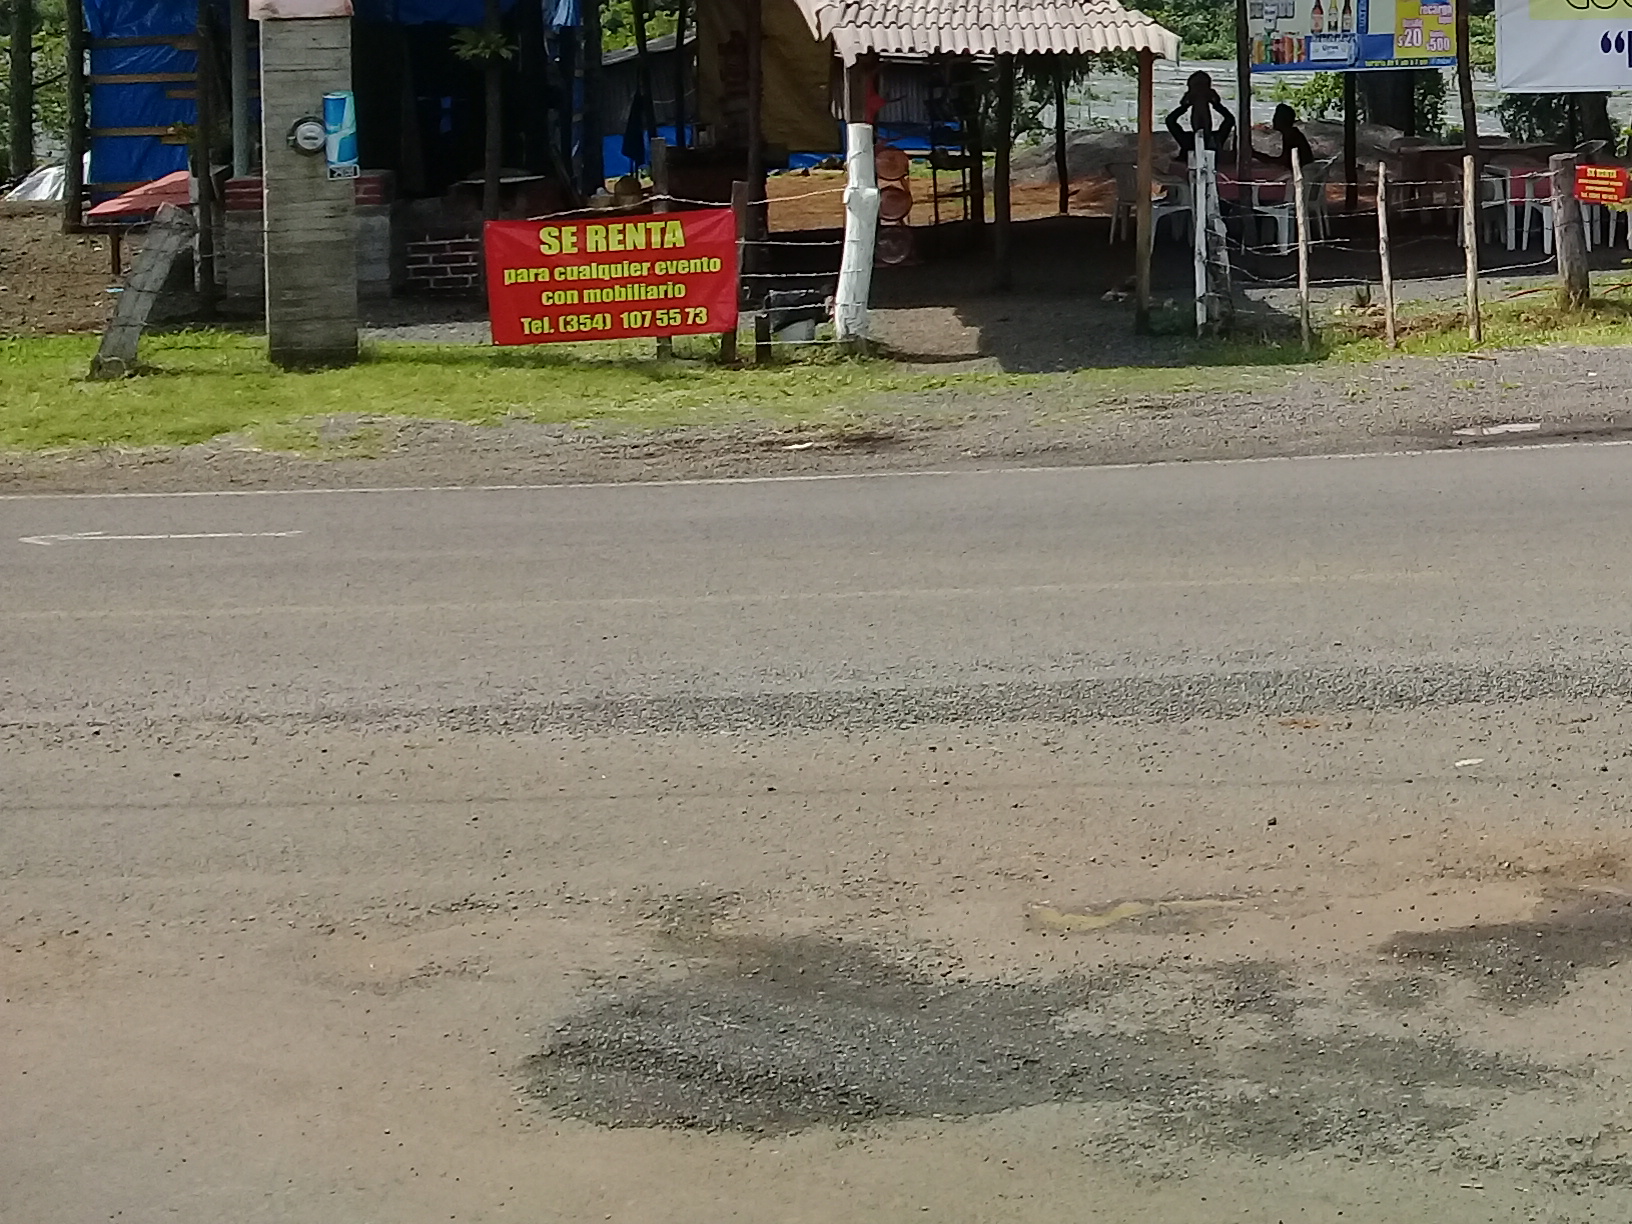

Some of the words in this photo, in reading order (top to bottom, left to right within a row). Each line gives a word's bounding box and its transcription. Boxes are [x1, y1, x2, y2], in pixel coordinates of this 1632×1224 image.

[538, 226, 579, 255] SE
[586, 220, 686, 253] RENTA
[504, 267, 549, 285] para
[554, 260, 651, 282] cualquier
[654, 257, 721, 276] evento
[541, 288, 579, 306] con
[583, 281, 686, 304] mobiliario
[521, 317, 555, 334] Tel.
[559, 312, 612, 333] (354)
[619, 310, 651, 330] 107
[656, 308, 682, 326] 55
[685, 306, 708, 325] 73
